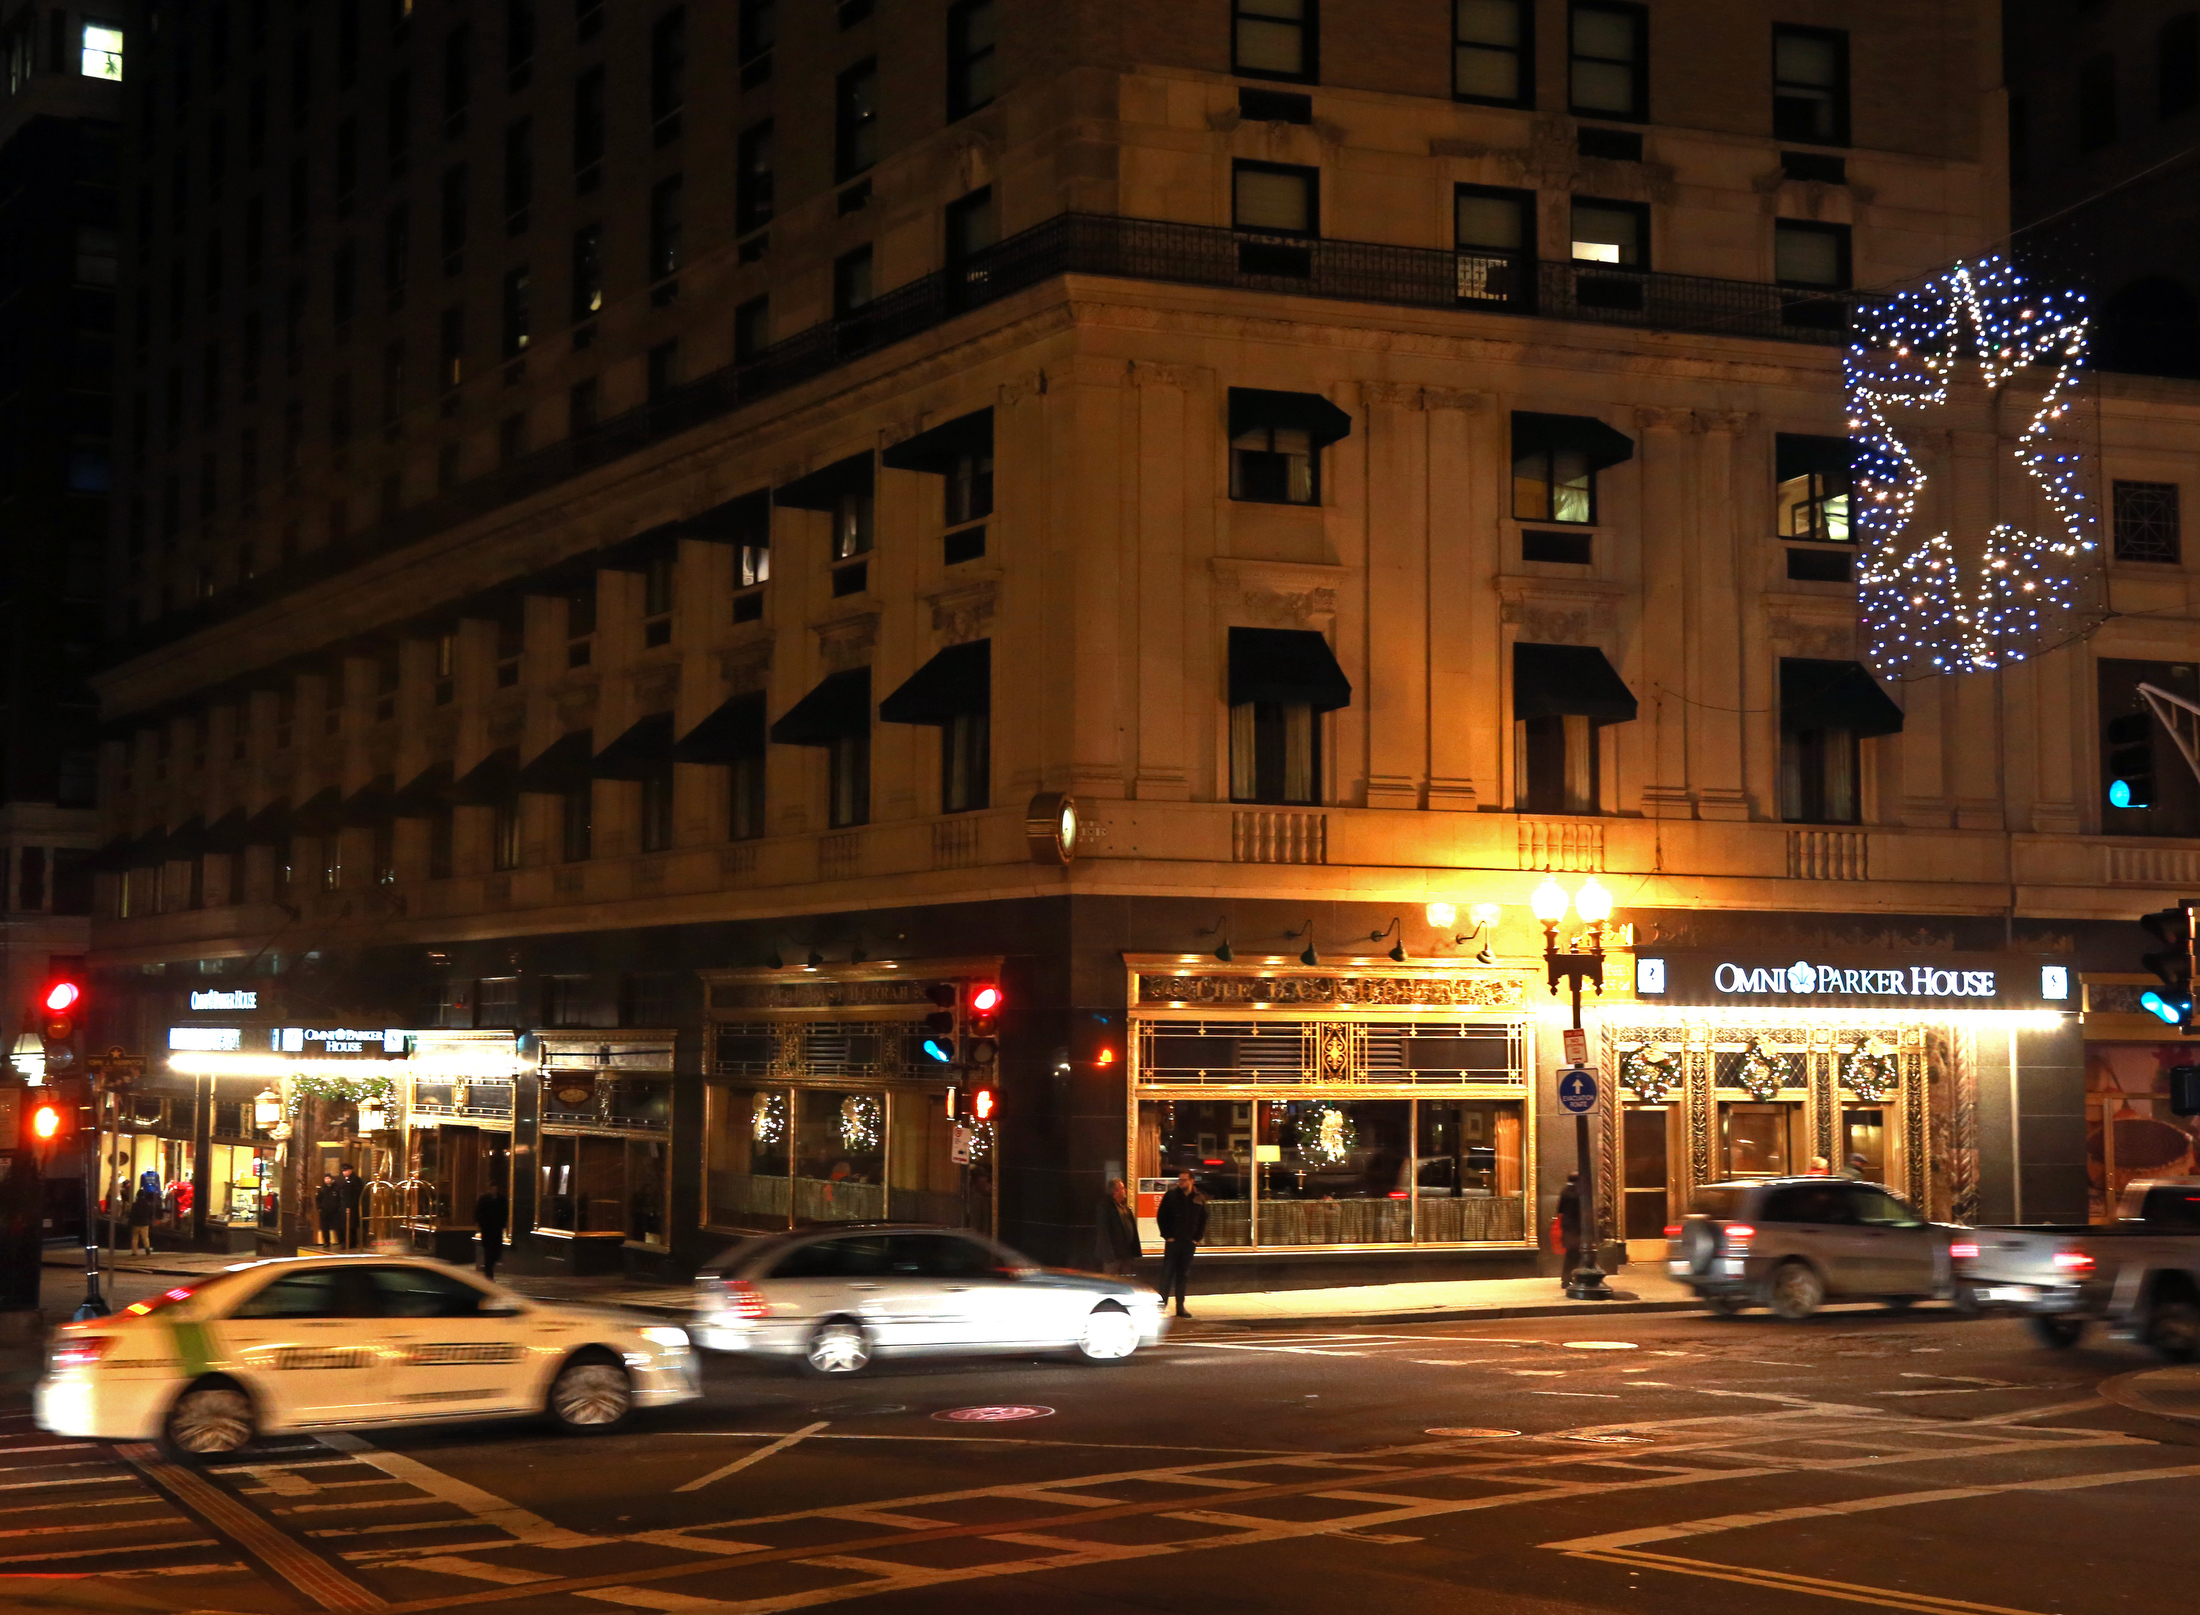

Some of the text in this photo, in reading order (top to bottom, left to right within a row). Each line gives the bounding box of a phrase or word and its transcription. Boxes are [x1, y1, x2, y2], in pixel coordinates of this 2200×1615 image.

[1714, 962, 1997, 997] OMNI PARKER HOUSE
[1196, 981, 1253, 998] THE
[304, 1028, 384, 1042] OMNI PARKER
[325, 1041, 363, 1053] HOUSE
[1563, 1094, 1594, 1102] EVACUATION
